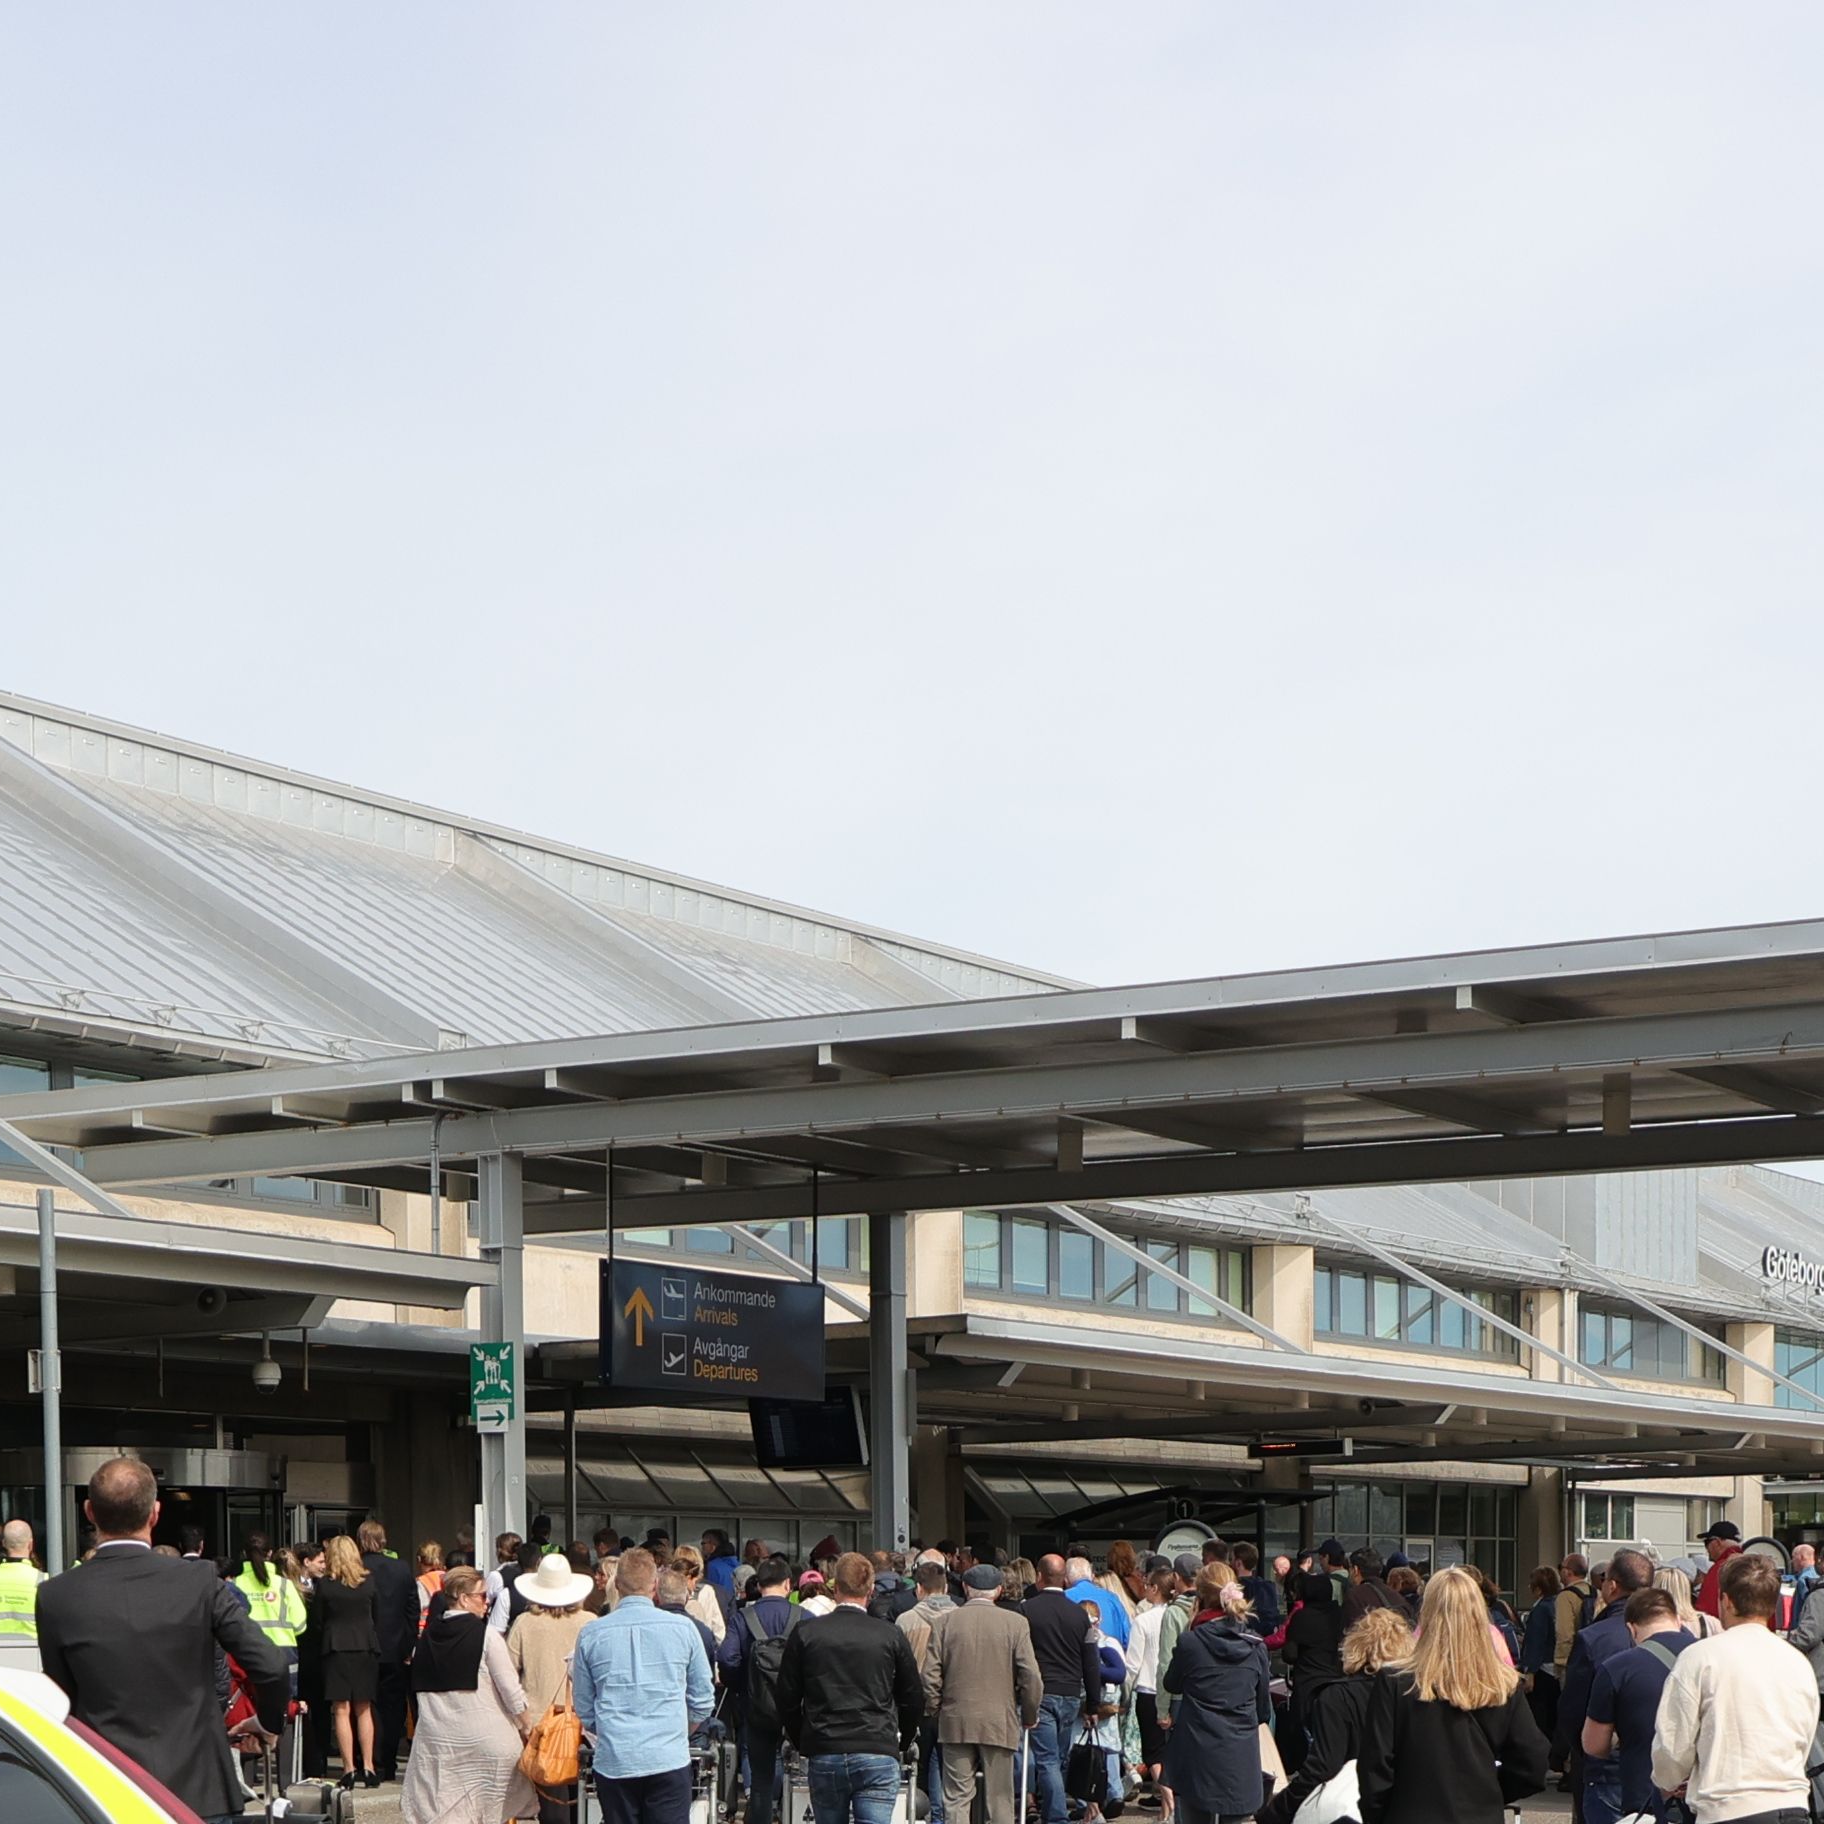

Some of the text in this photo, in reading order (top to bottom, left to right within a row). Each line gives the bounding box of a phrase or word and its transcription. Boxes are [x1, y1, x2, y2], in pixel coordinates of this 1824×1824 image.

[693, 1281, 776, 1308] Ankommande
[694, 1305, 738, 1326] Arrivals
[693, 1337, 750, 1362] Avgångar
[693, 1359, 758, 1382] Departures
[1181, 1502, 1187, 1518] 1
